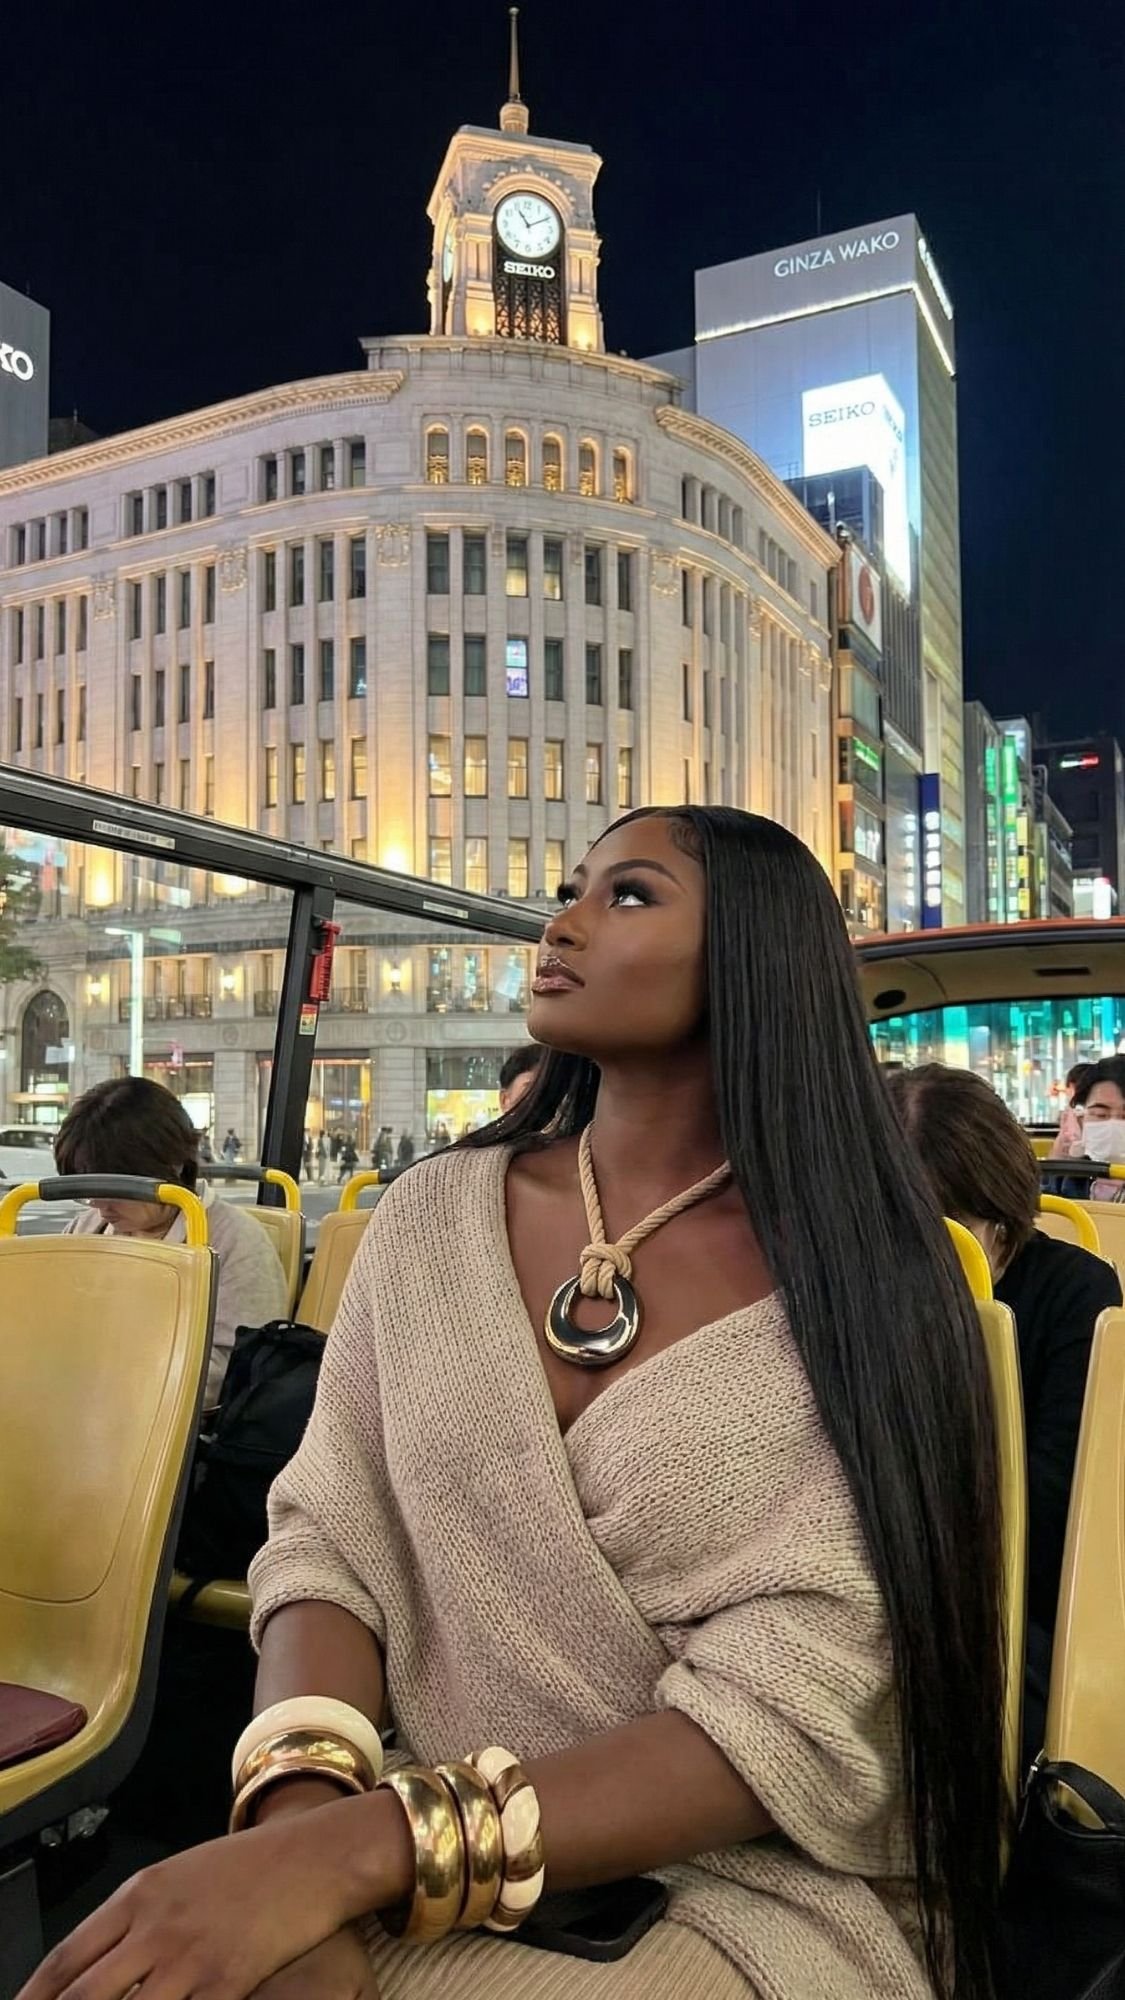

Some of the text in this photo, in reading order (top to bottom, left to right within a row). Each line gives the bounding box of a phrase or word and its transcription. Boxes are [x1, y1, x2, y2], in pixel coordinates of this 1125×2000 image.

[774, 232, 899, 277] GINZA WAKO
[504, 261, 555, 279] SEIKO
[808, 401, 875, 427] SEIKO
